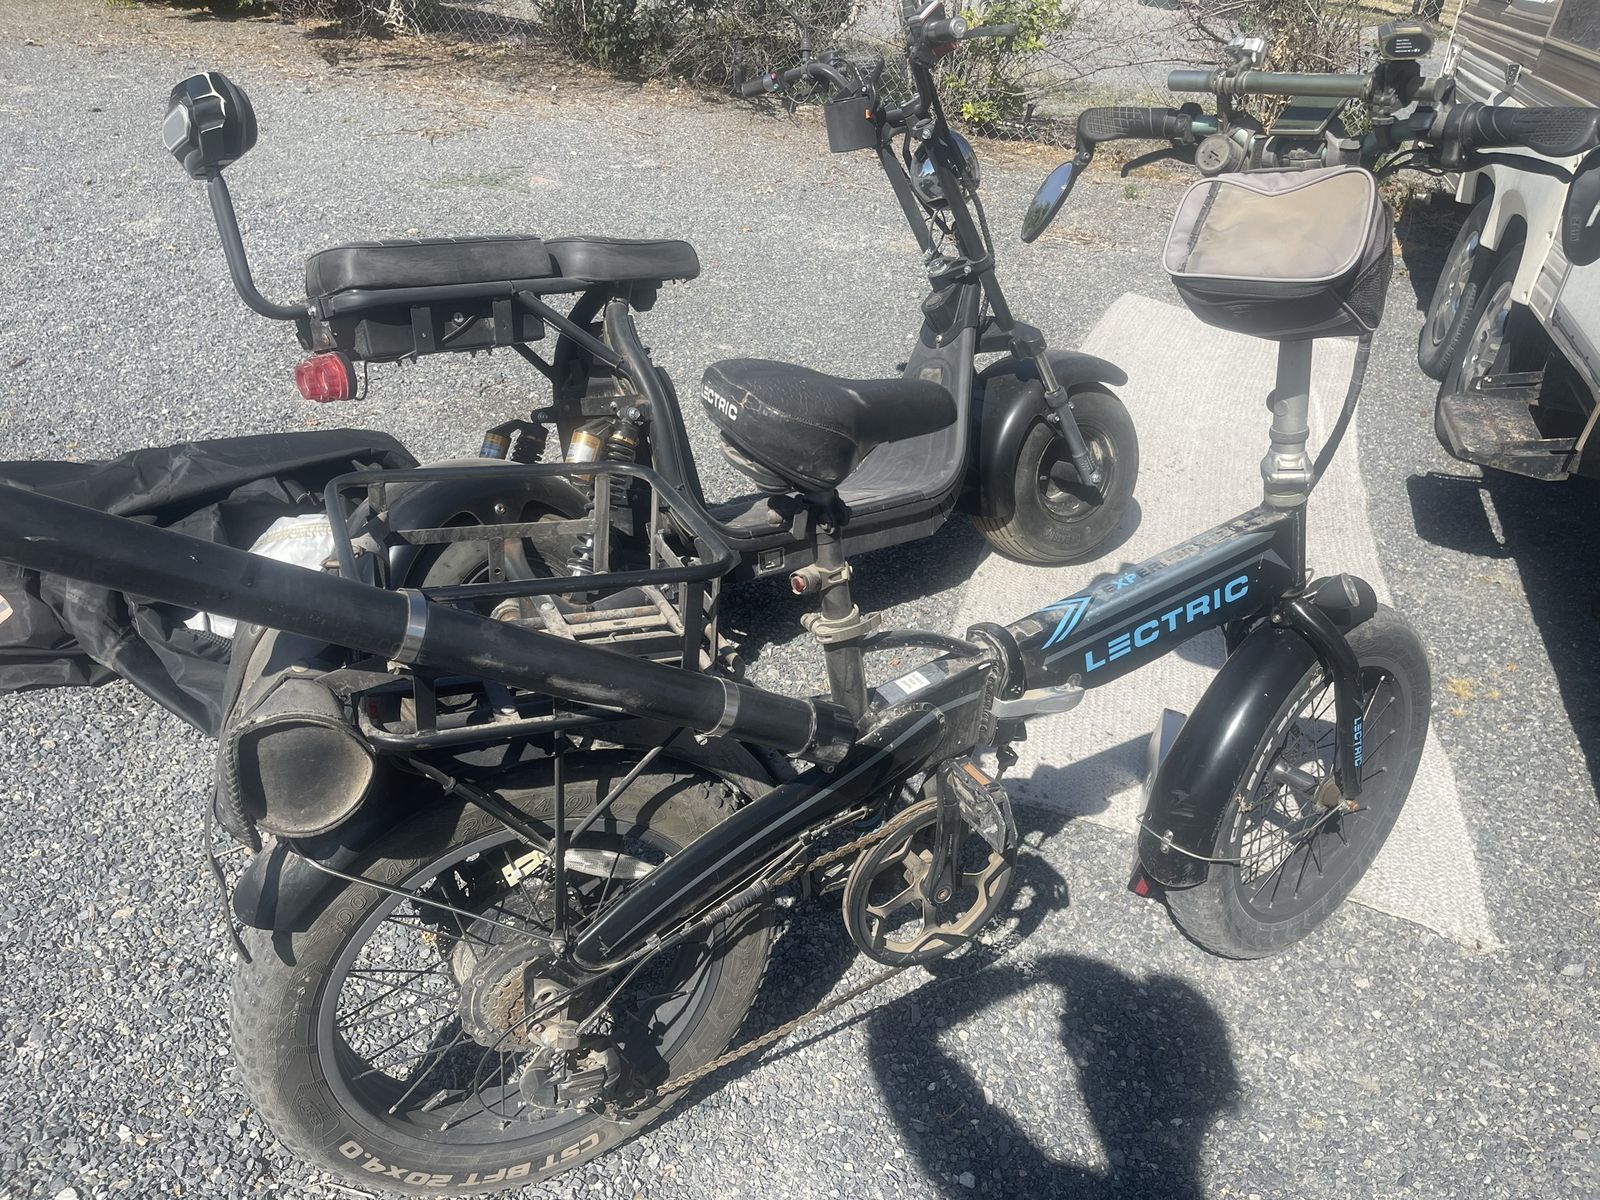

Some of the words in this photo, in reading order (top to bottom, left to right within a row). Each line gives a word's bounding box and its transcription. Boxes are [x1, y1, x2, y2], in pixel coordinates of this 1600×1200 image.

[701, 383, 738, 421] LECTRIC
[1085, 575, 1249, 673] LECTRIC
[1353, 716, 1363, 767] LECTRIC
[539, 1133, 599, 1171] CST
[458, 1162, 531, 1187] BFT
